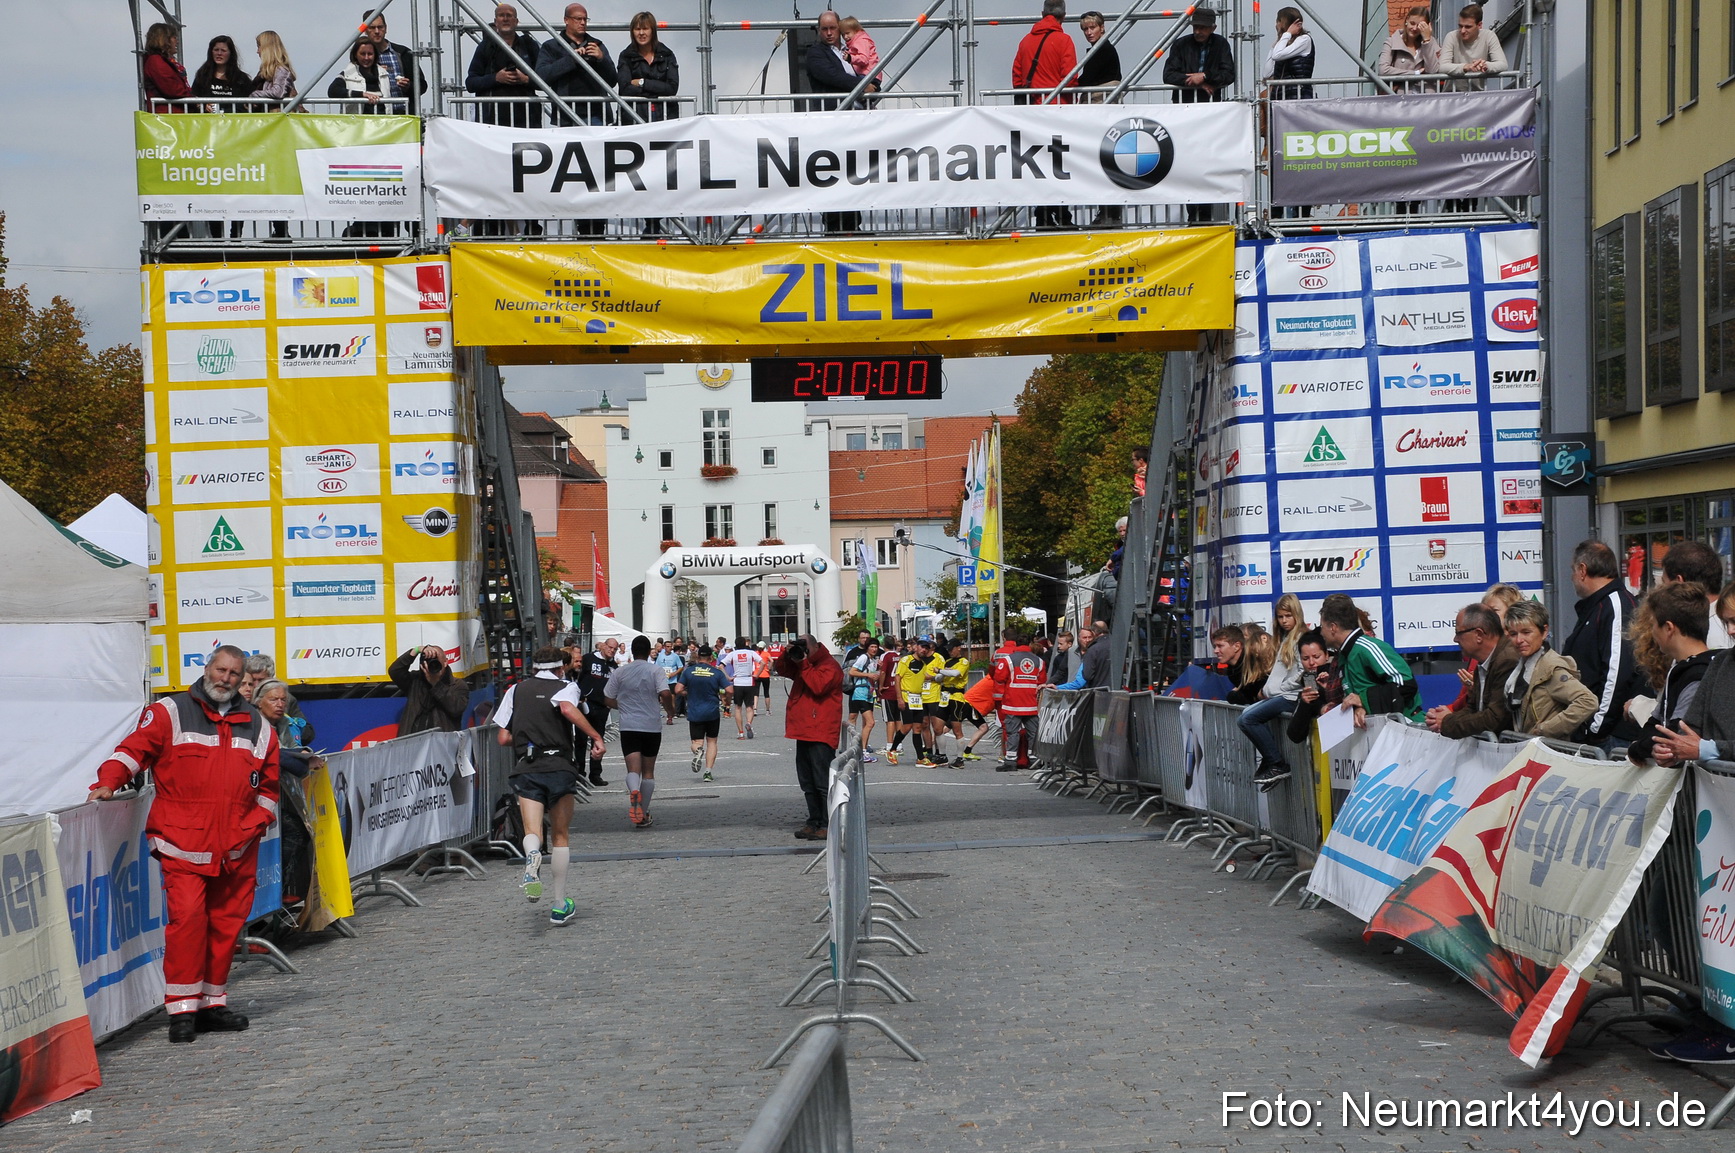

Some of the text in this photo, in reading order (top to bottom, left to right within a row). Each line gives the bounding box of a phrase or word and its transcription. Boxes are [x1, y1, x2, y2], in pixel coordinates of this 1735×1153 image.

[1106, 118, 1169, 142] BMW
[1426, 126, 1486, 143] OFFICE
[1285, 129, 1411, 157] BOCK
[511, 130, 1072, 193] PARTL Neumarkt
[1283, 158, 1418, 172] inspired by smart concepts
[162, 162, 266, 185] langgeht!
[324, 183, 408, 197] NeuerMarkt
[1286, 252, 1326, 260] GERHART
[1375, 260, 1438, 274] RAIL.ONE
[1304, 278, 1323, 287] KIA
[419, 291, 445, 302] Braun
[759, 262, 934, 323] ZIEL
[1028, 282, 1195, 304] Neumarkter Stadtlauf
[217, 301, 261, 312] energie
[330, 296, 357, 305] KANN
[494, 298, 661, 314] Neumarkter Stadtlauf
[1279, 316, 1353, 331] Neumarkter Tagblatt
[1381, 310, 1465, 331] NATHUS
[199, 335, 232, 356] RUND
[282, 342, 342, 360] swn
[199, 355, 237, 374] SCHAU
[322, 358, 357, 366] neumarkt
[793, 360, 929, 397] 2:00:00
[1492, 368, 1537, 384] swn
[1299, 379, 1364, 394] VARIOTEC
[1430, 385, 1472, 397] energie
[174, 416, 238, 426] RAIL.ONE
[1395, 427, 1469, 454] Charivari
[305, 454, 346, 462] GERHART
[200, 471, 265, 486] VARIOTEC
[322, 480, 343, 490] KIA
[1283, 504, 1346, 515] RAIL.ONE
[1421, 501, 1448, 514] Braun
[424, 518, 448, 527] MINI
[335, 536, 378, 547] energie
[682, 552, 806, 568] BMW Laufsport
[1287, 555, 1346, 574] swn
[1416, 562, 1461, 572] Neumarkter
[1286, 571, 1360, 582] stadtwerke neumarkt
[1409, 569, 1470, 584] Lammsbräu
[296, 582, 372, 595] Neumarkter Tagblatt
[181, 595, 244, 608] RAIL.ONE
[315, 645, 381, 659] VARIOTEC
